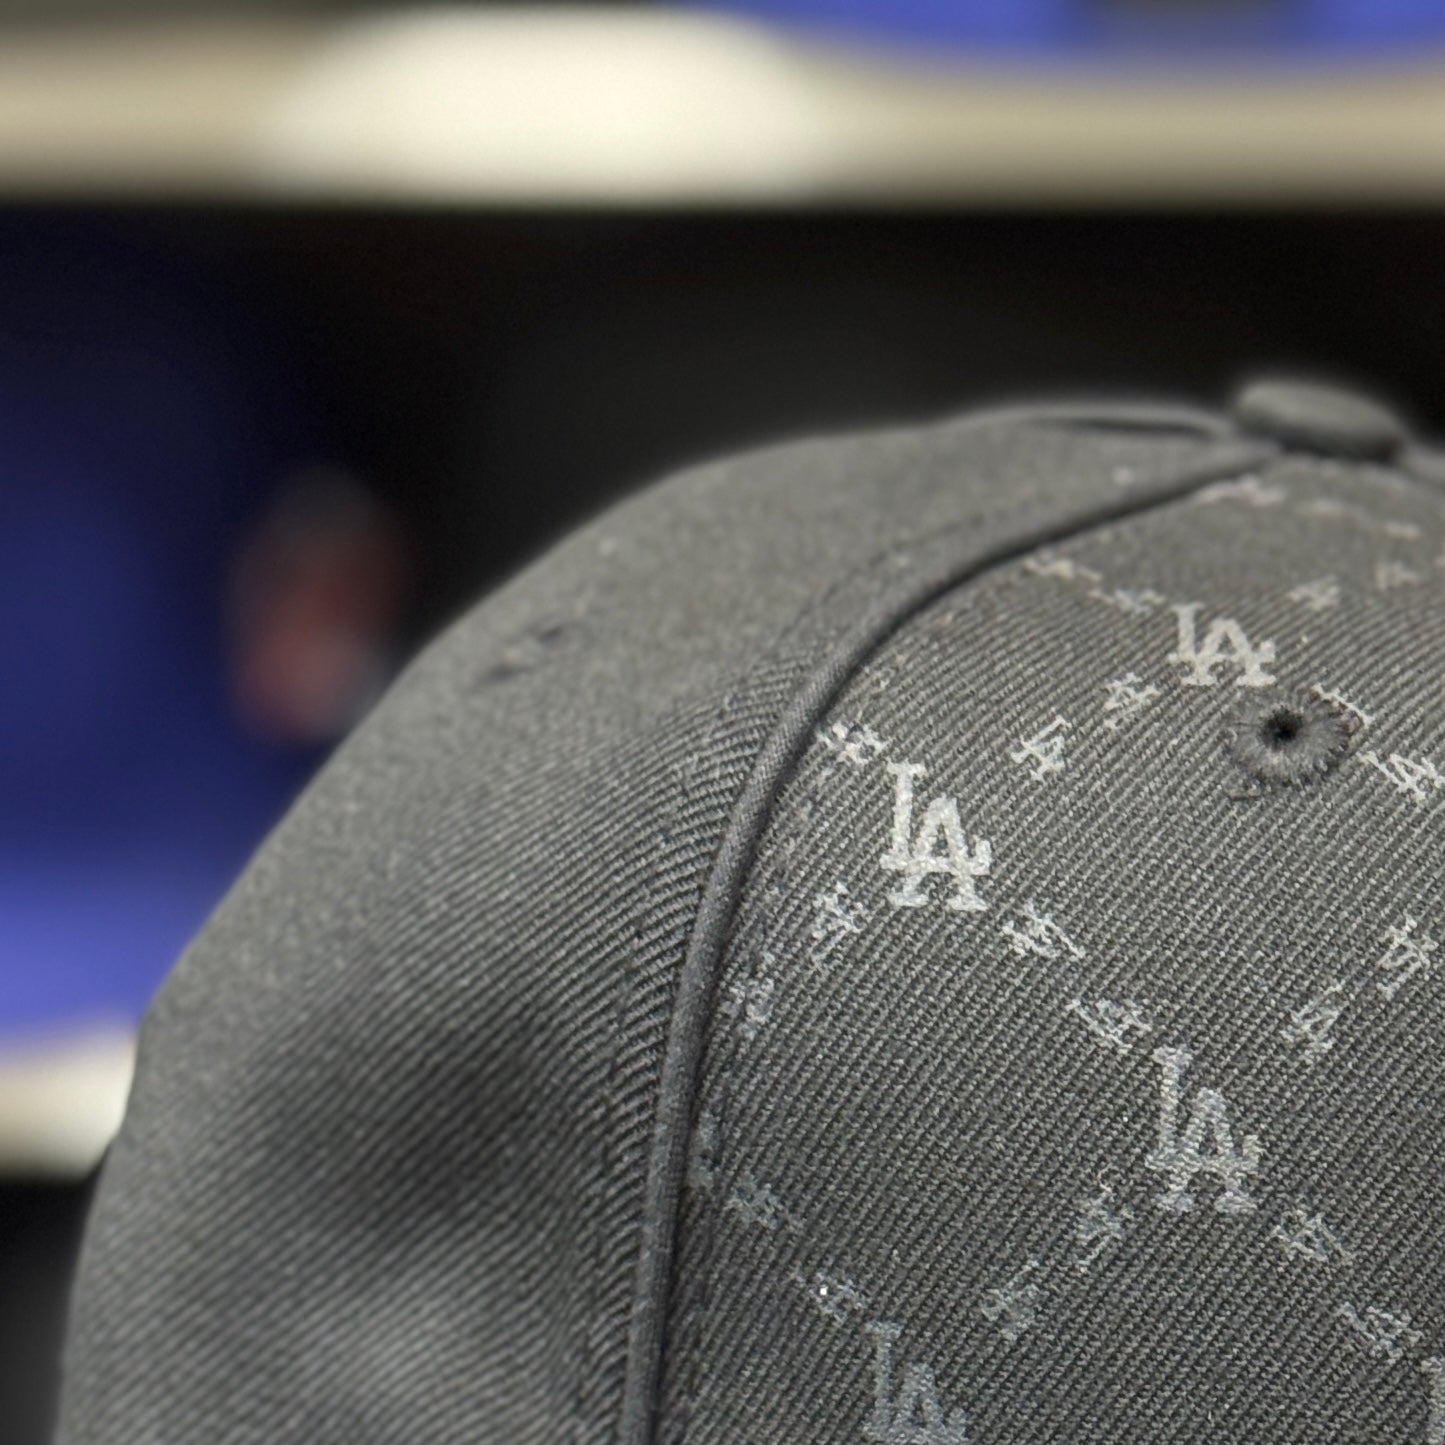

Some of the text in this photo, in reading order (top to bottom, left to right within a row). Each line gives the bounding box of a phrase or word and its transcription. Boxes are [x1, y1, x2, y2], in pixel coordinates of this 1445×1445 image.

[1167, 603, 1276, 687] LA
[880, 761, 992, 911] LA
[1145, 1044, 1264, 1214] LA
